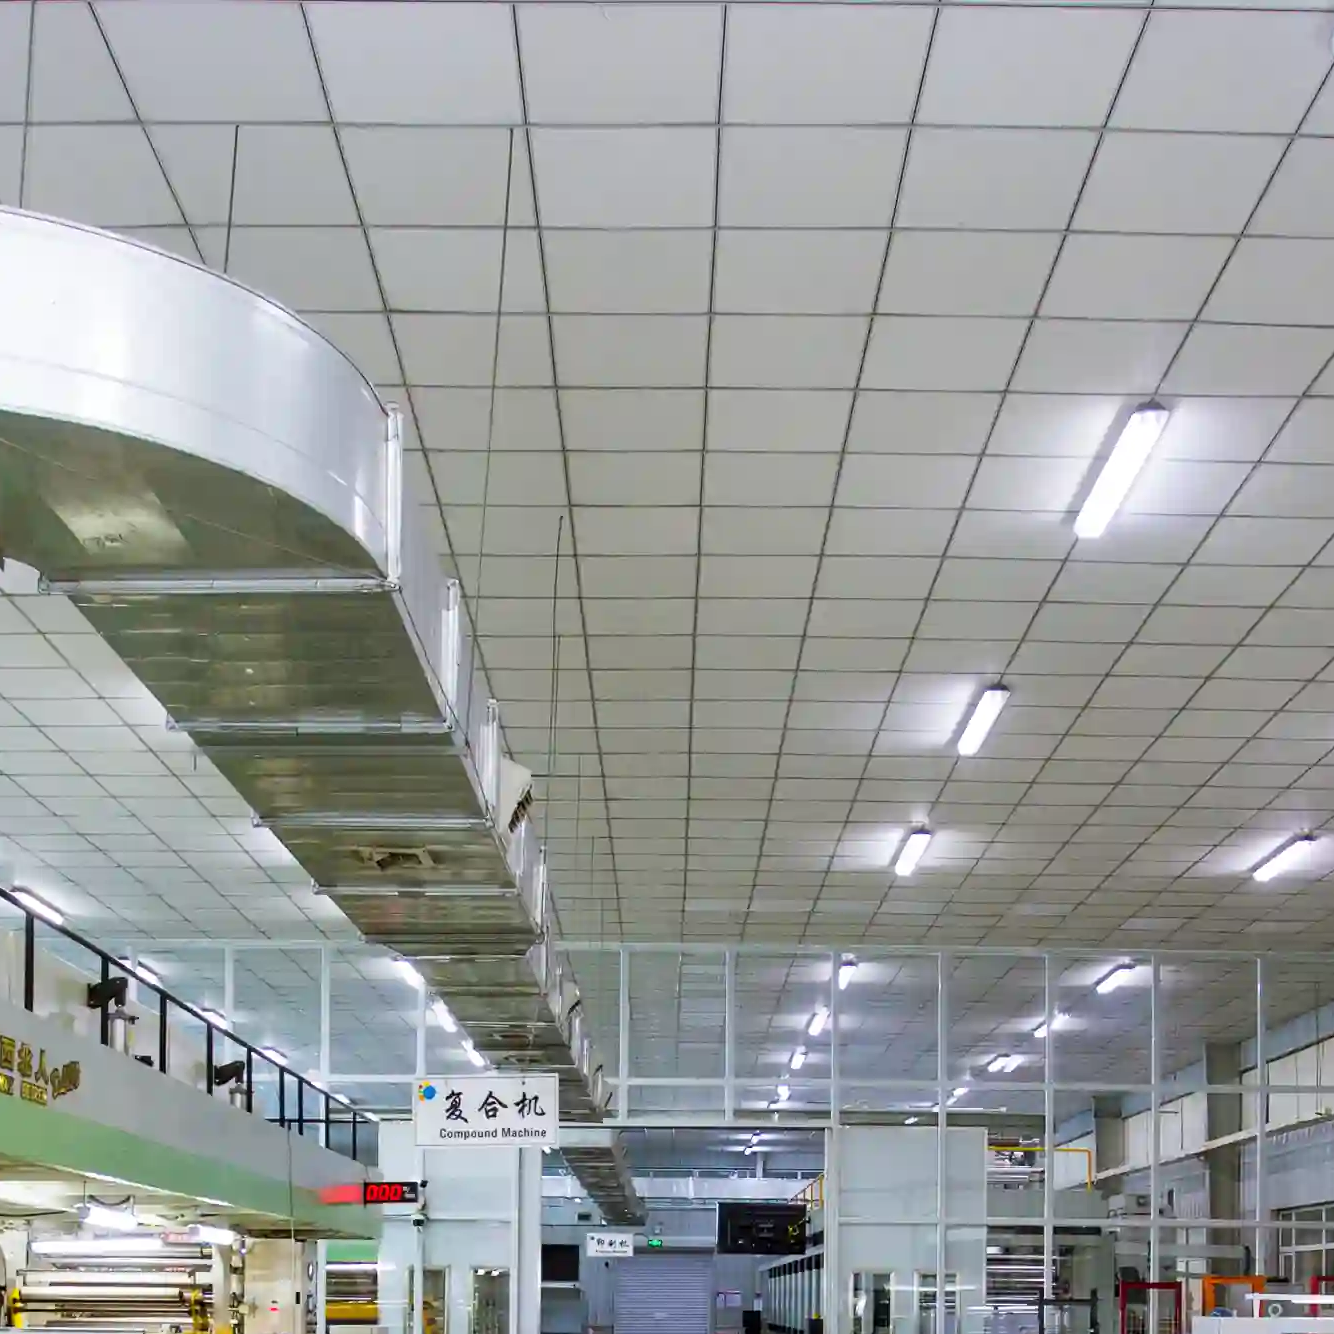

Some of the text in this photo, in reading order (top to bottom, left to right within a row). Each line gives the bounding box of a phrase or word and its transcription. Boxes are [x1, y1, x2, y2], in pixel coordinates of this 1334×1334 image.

[444, 1090, 547, 1123] 复合机
[439, 1127, 547, 1140] Compound Machine
